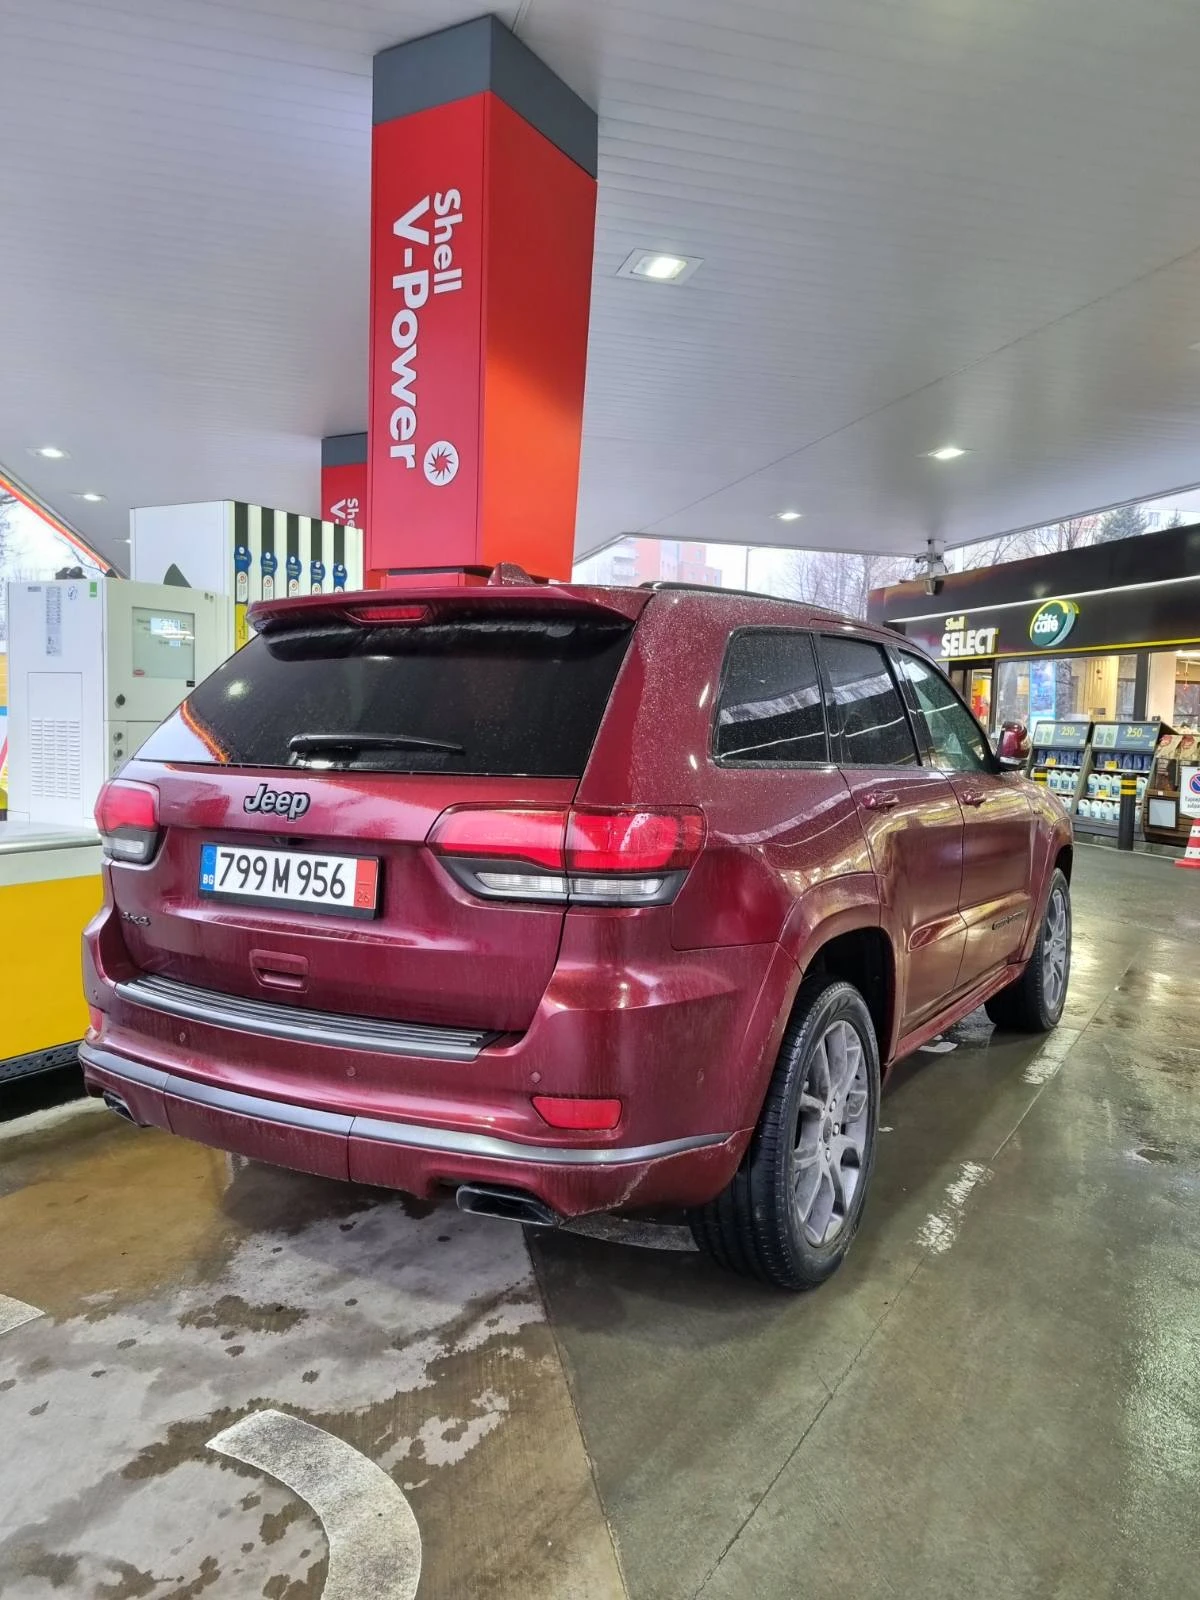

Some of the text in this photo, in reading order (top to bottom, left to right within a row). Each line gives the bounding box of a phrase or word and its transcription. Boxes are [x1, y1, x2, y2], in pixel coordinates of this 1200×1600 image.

[433, 188, 463, 294] Shell
[390, 195, 430, 469] V-Power
[347, 498, 359, 528] She
[940, 628, 997, 656] SELECT
[944, 617, 965, 631] Shell
[243, 783, 311, 822] Jeep
[202, 852, 346, 900] BG 799 M 956
